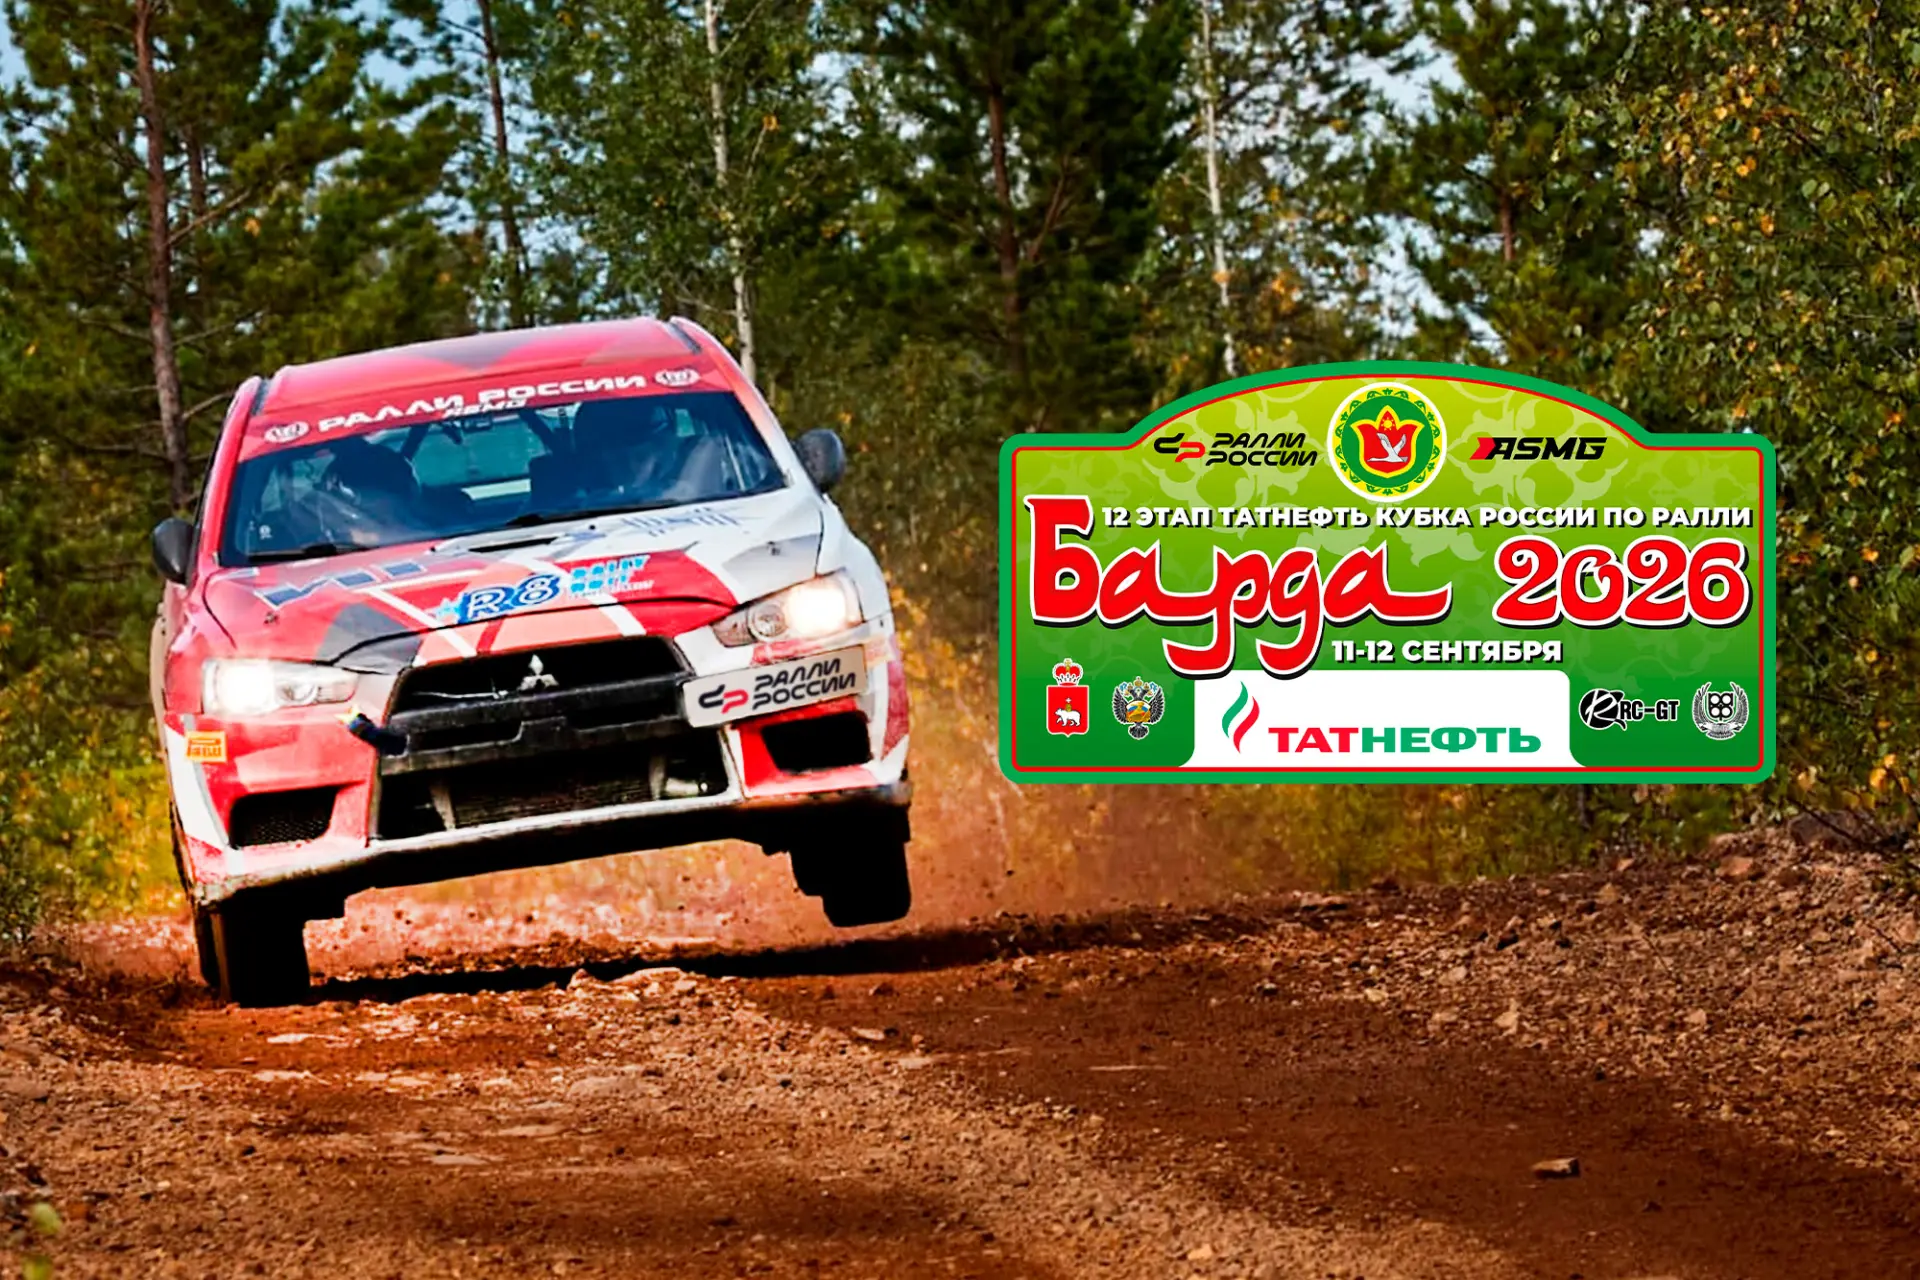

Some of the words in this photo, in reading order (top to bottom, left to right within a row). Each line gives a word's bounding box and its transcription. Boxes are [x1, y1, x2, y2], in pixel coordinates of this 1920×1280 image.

[318, 394, 464, 432] РАЛЛИ
[478, 375, 648, 403] РОССИИ
[752, 672, 857, 711] РОССИИ
[754, 657, 841, 692] РАЛЛИ
